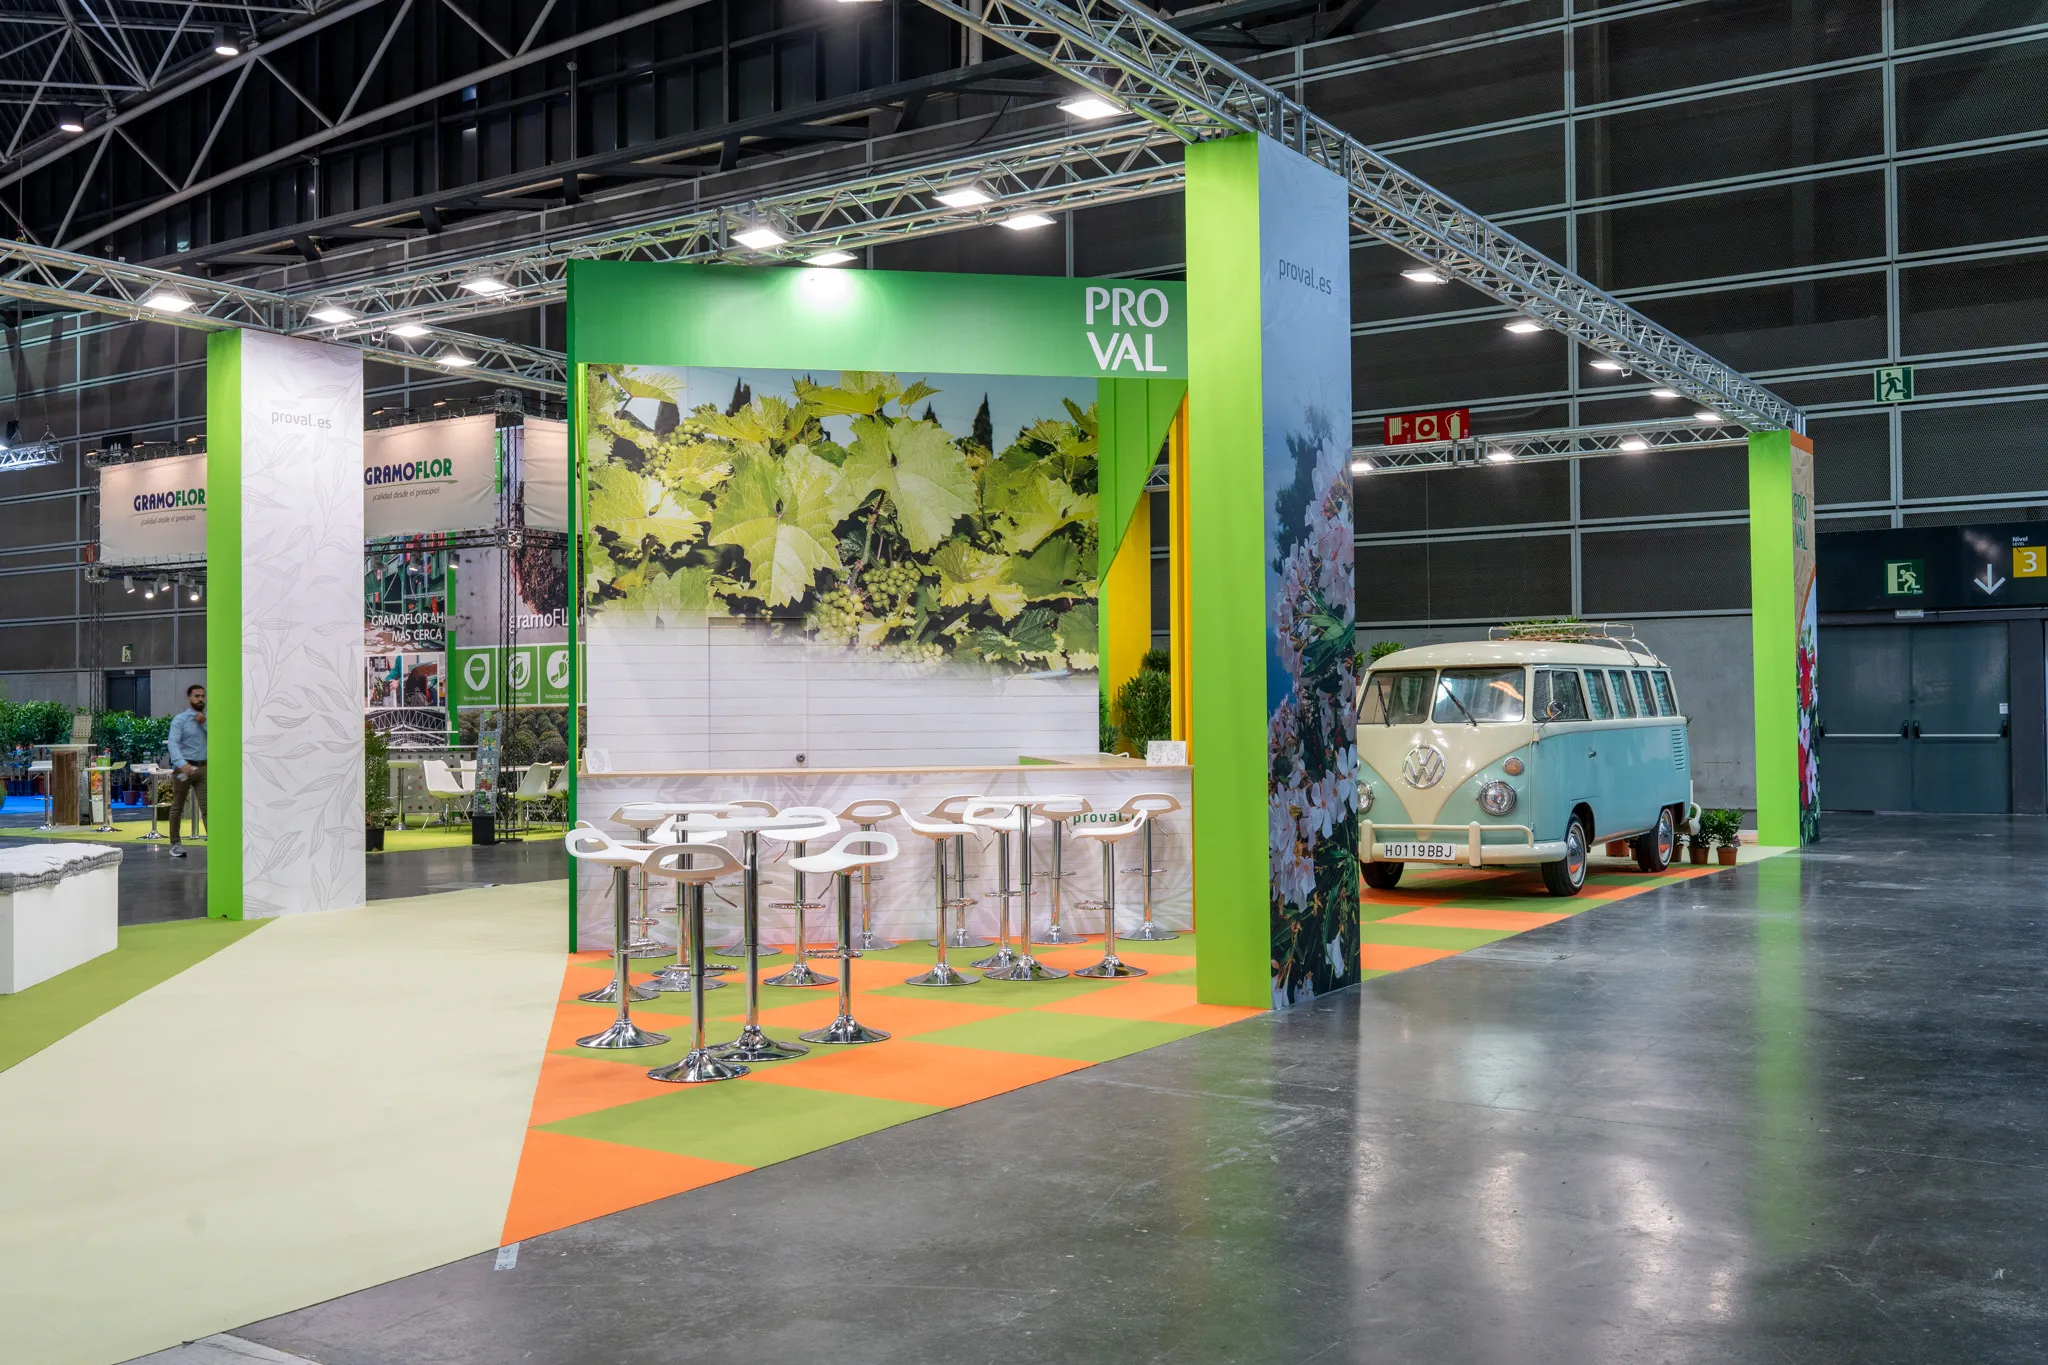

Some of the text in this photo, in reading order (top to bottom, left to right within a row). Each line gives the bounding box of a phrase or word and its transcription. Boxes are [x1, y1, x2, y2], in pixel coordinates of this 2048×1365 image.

[1279, 259, 1332, 295] proval.es
[1085, 286, 1169, 328] PRO
[1086, 331, 1168, 372] VAL
[271, 411, 332, 429] proval.es
[363, 457, 453, 486] GRAMOFLOR
[133, 488, 206, 512] GRAMOFLOR
[393, 490, 409, 499] desde
[409, 489, 415, 497] el
[1793, 492, 1808, 521] PRO
[1793, 521, 1808, 551] VAL
[2022, 551, 2038, 573] 3
[371, 611, 446, 627] GRAMOFLOR AH
[413, 628, 443, 641] CERCA
